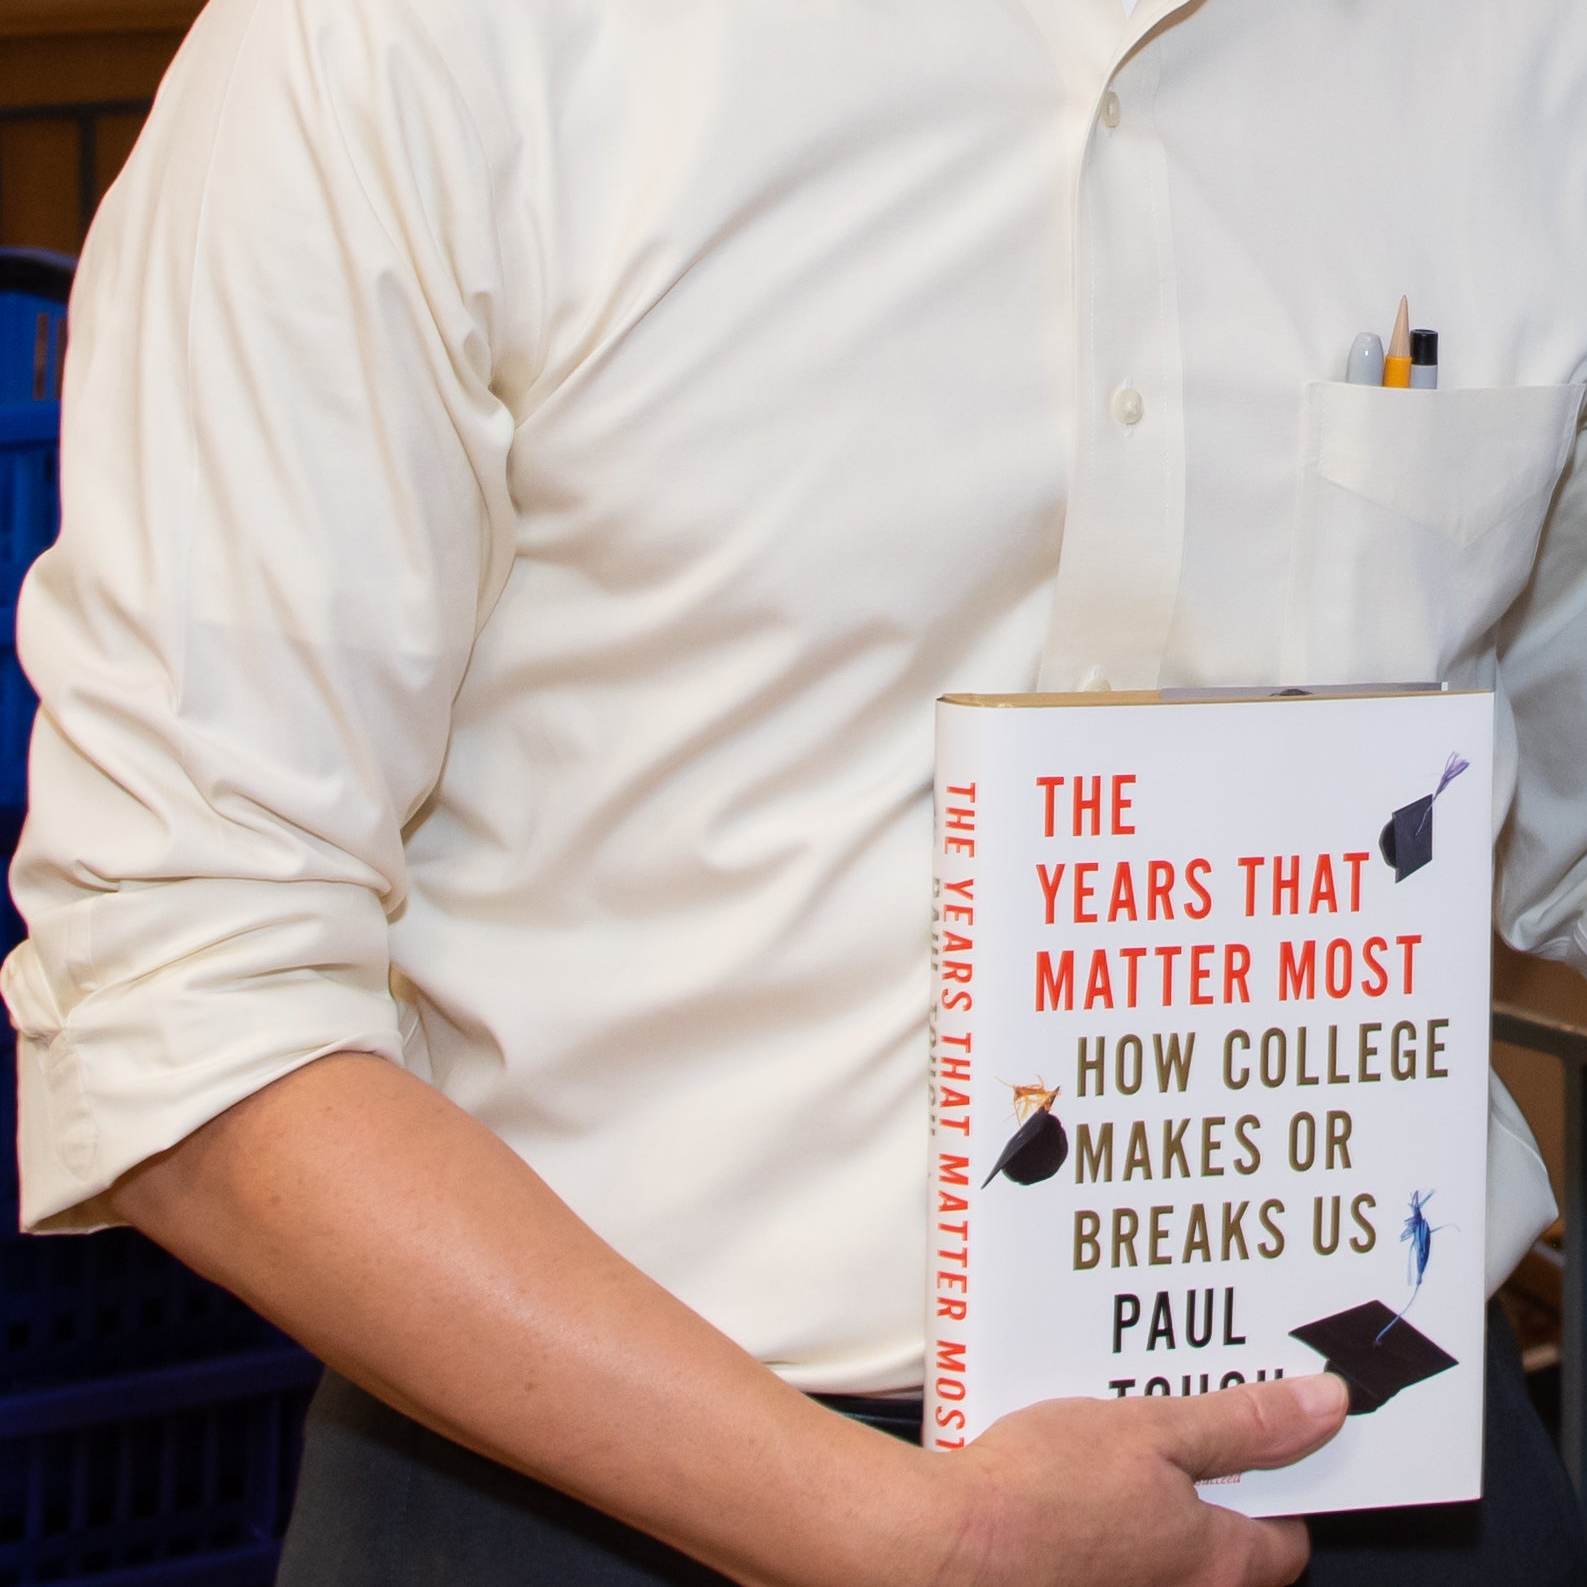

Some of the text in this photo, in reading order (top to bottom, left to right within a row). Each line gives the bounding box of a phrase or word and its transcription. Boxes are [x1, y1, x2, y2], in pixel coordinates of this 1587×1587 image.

[1036, 774, 1137, 838] THE
[1035, 851, 1370, 925] YEARS THAT
[1035, 934, 1422, 1013] MATTER MOST
[1076, 1017, 1450, 1098] HOW COLLEGE
[934, 782, 976, 1450] THE YEARS THAT MATTER MOST
[1074, 1109, 1354, 1185] MAKES OR
[1072, 1192, 1378, 1272] BREAKS US
[1112, 1286, 1247, 1354] PAUL
